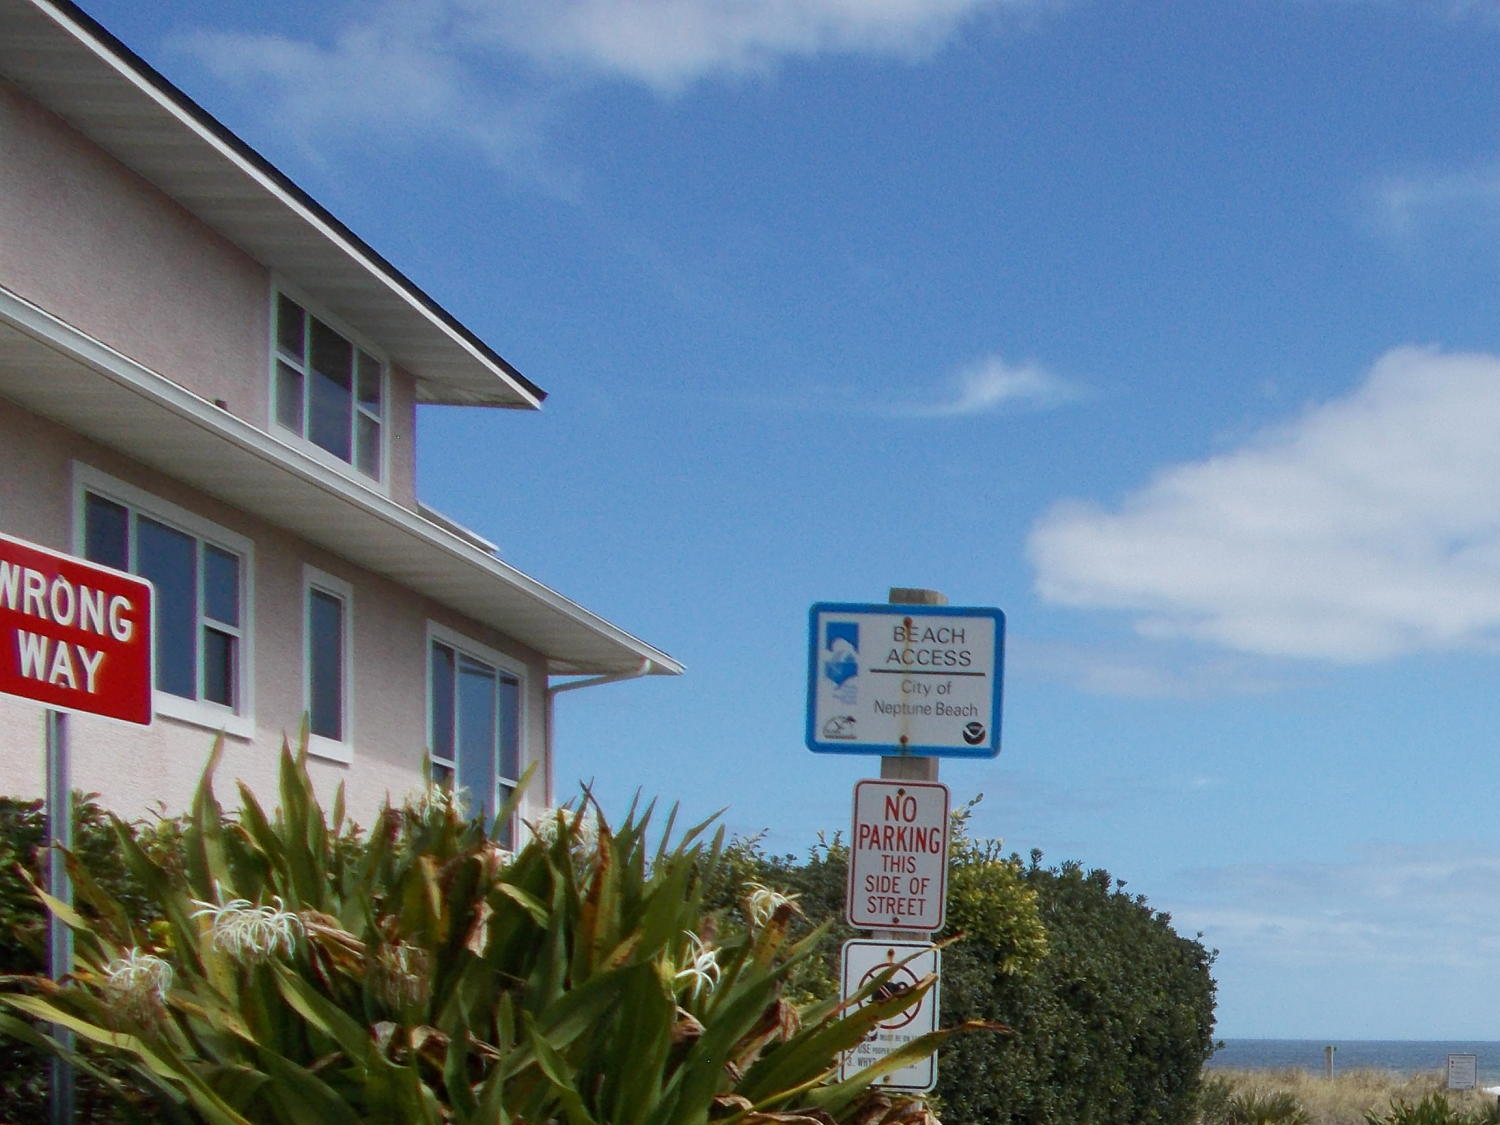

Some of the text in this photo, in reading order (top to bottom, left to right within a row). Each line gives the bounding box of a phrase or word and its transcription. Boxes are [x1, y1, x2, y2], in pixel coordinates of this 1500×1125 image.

[0, 560, 133, 643] WRONG
[893, 626, 965, 644] BEACH
[17, 628, 105, 694] WAY
[886, 648, 972, 667] ACCESS
[901, 679, 952, 697] City of
[874, 699, 978, 717] Neptune Beach
[884, 795, 917, 823] NO
[859, 824, 941, 854] PARKING
[881, 854, 917, 874] THIS
[864, 874, 931, 895] SIDE OF
[866, 895, 926, 916] STREET
